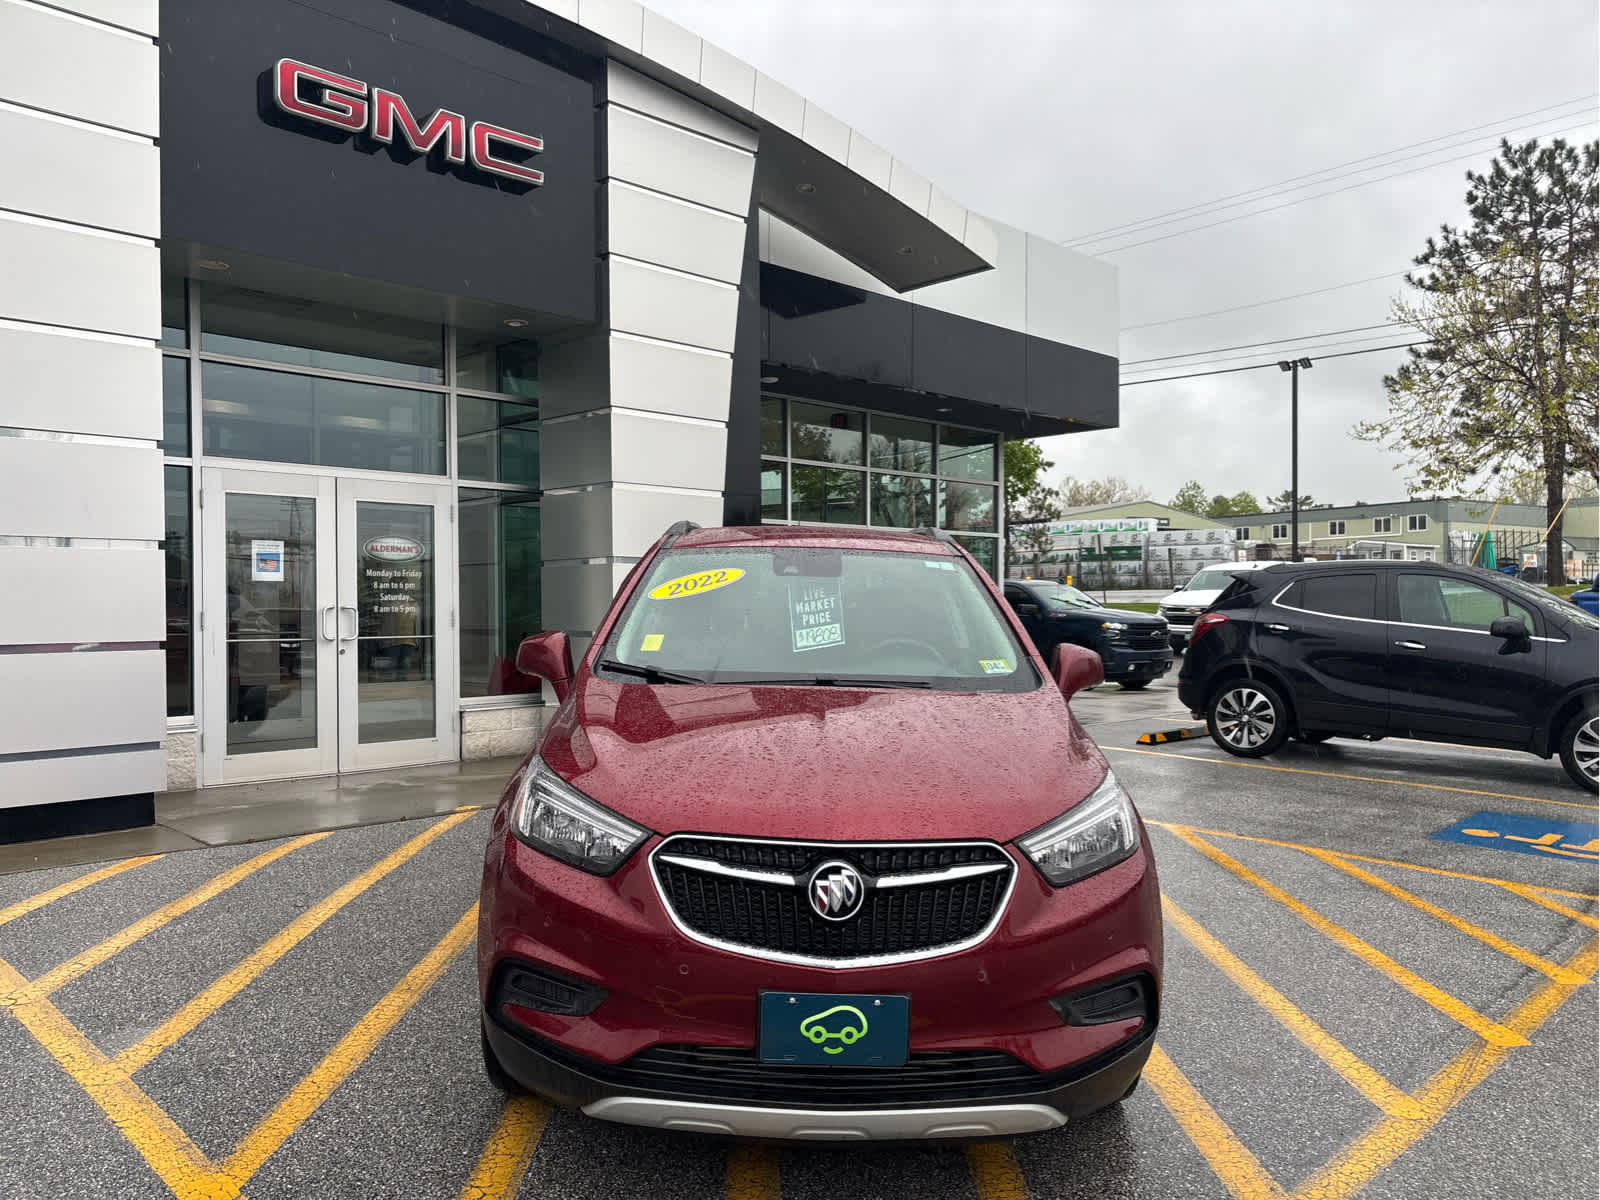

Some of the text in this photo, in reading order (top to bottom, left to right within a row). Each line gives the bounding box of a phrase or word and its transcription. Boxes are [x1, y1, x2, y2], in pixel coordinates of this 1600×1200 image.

[275, 57, 544, 185] GMC
[366, 568, 392, 579] Monday
[402, 569, 423, 579] Friday
[373, 581, 378, 589] 8
[405, 583, 416, 591] pm
[668, 571, 728, 597] 2022
[380, 593, 410, 602] Saturday
[803, 586, 826, 601] LIVE
[405, 606, 416, 614] pm
[796, 597, 836, 615] MARKET
[802, 611, 832, 626] PRICE
